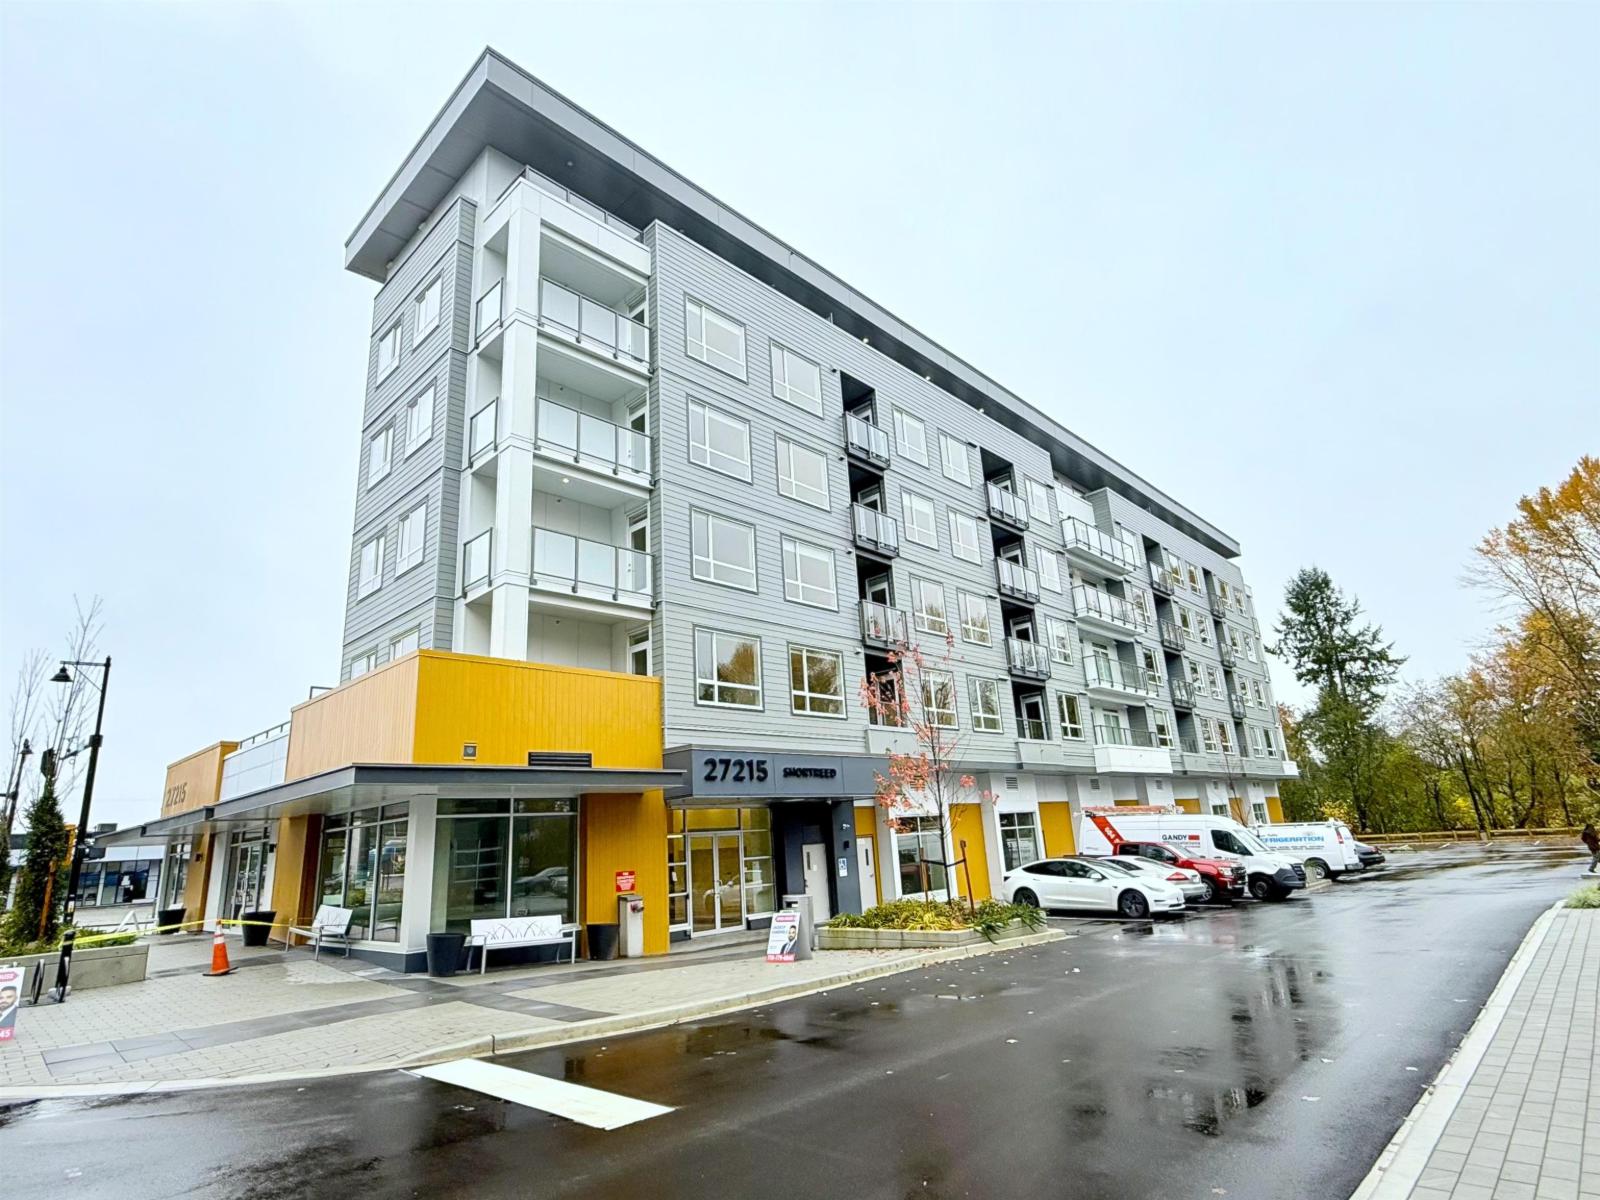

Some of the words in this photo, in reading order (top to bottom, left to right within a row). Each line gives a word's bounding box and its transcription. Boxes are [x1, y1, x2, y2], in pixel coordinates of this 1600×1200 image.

[704, 758, 768, 782] 27215
[783, 767, 837, 778] SHORTREED
[166, 782, 188, 807] 27215
